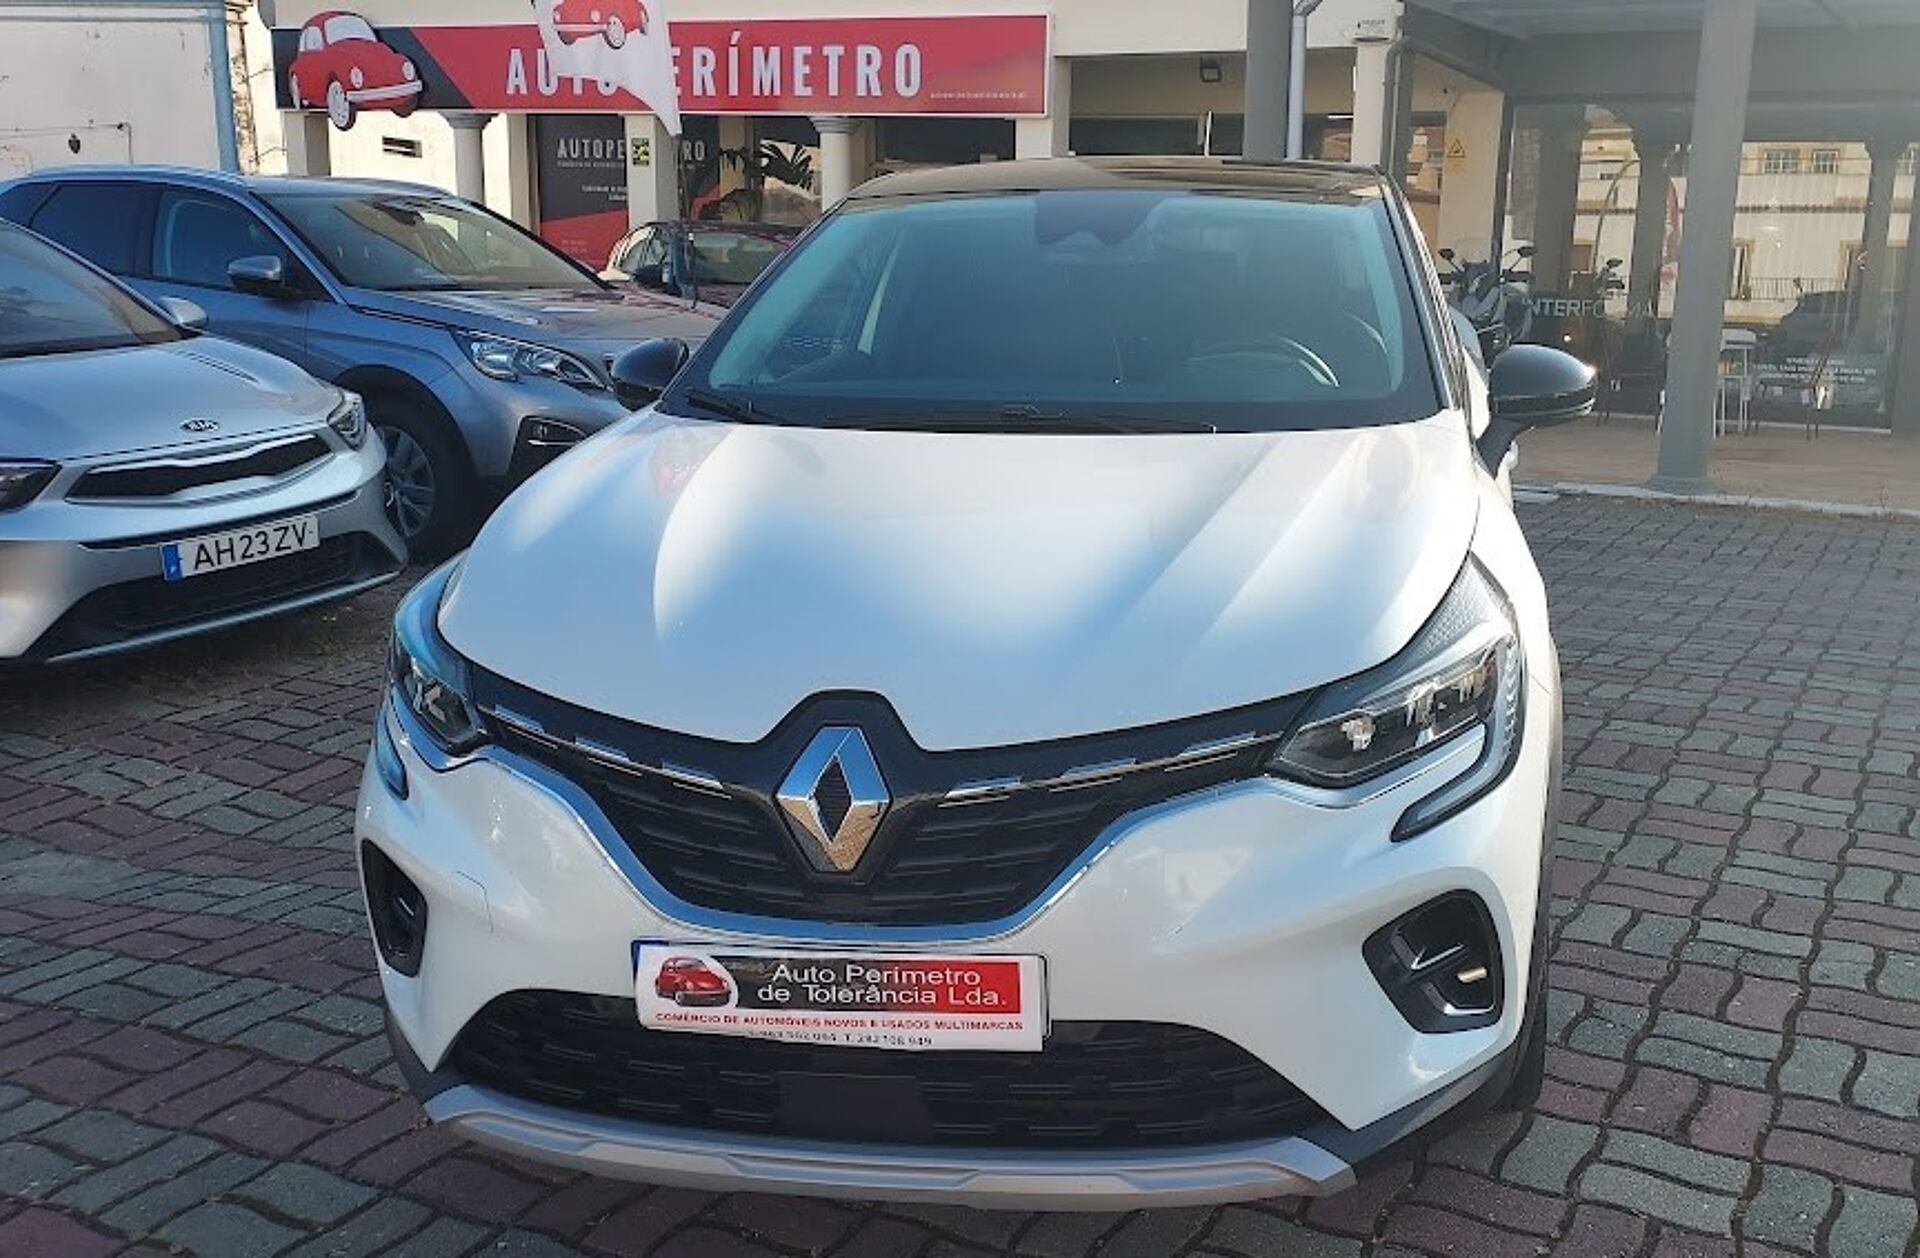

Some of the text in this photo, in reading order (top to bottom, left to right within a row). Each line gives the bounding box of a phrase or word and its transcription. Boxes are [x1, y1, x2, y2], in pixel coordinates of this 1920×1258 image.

[772, 964, 836, 984] Auto
[757, 984, 1006, 1006] de Tolerância Lda.
[723, 1014, 740, 1025] DE
[823, 1018, 867, 1029] NOVOS
[882, 1020, 930, 1030] USADOS
[935, 1021, 1024, 1031] MULTIMARCAS
